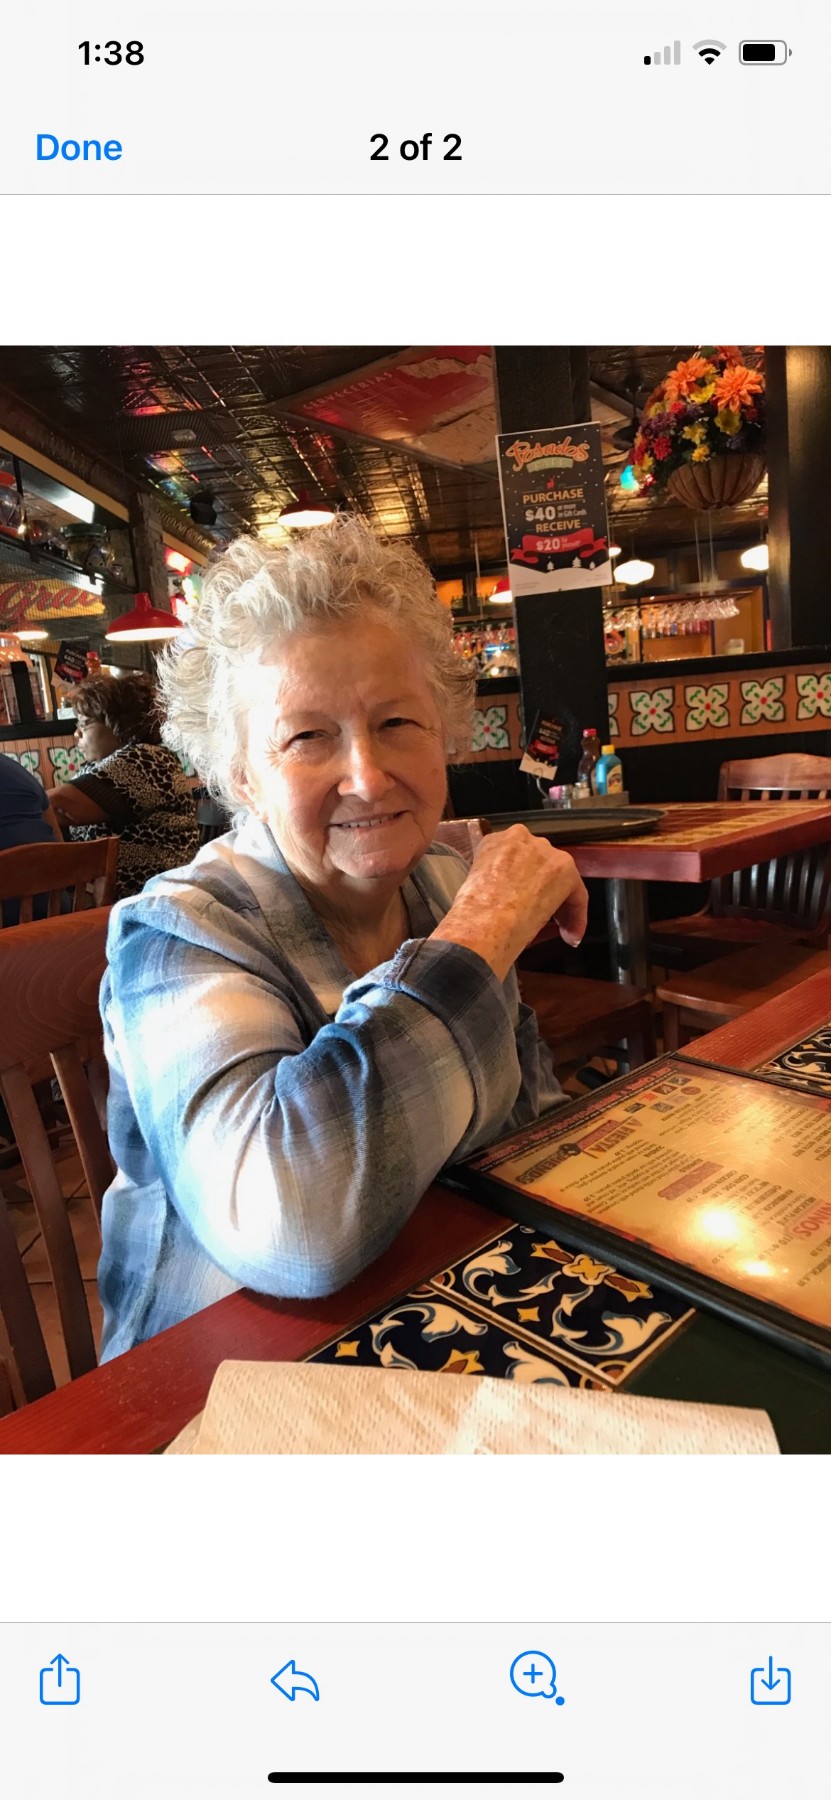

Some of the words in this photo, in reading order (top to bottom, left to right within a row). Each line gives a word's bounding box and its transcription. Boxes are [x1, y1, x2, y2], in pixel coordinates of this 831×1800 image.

[79, 41, 144, 66] 1:38
[37, 134, 122, 160] Done
[370, 133, 389, 160] 2
[400, 133, 432, 161] of
[443, 134, 462, 160] 2
[505, 436, 590, 471] Posados
[523, 488, 584, 504] PURCHASE
[525, 506, 556, 521] $40
[536, 519, 581, 533] RECEIVE
[536, 538, 560, 551] $20
[588, 1125, 638, 1154] FIESTA
